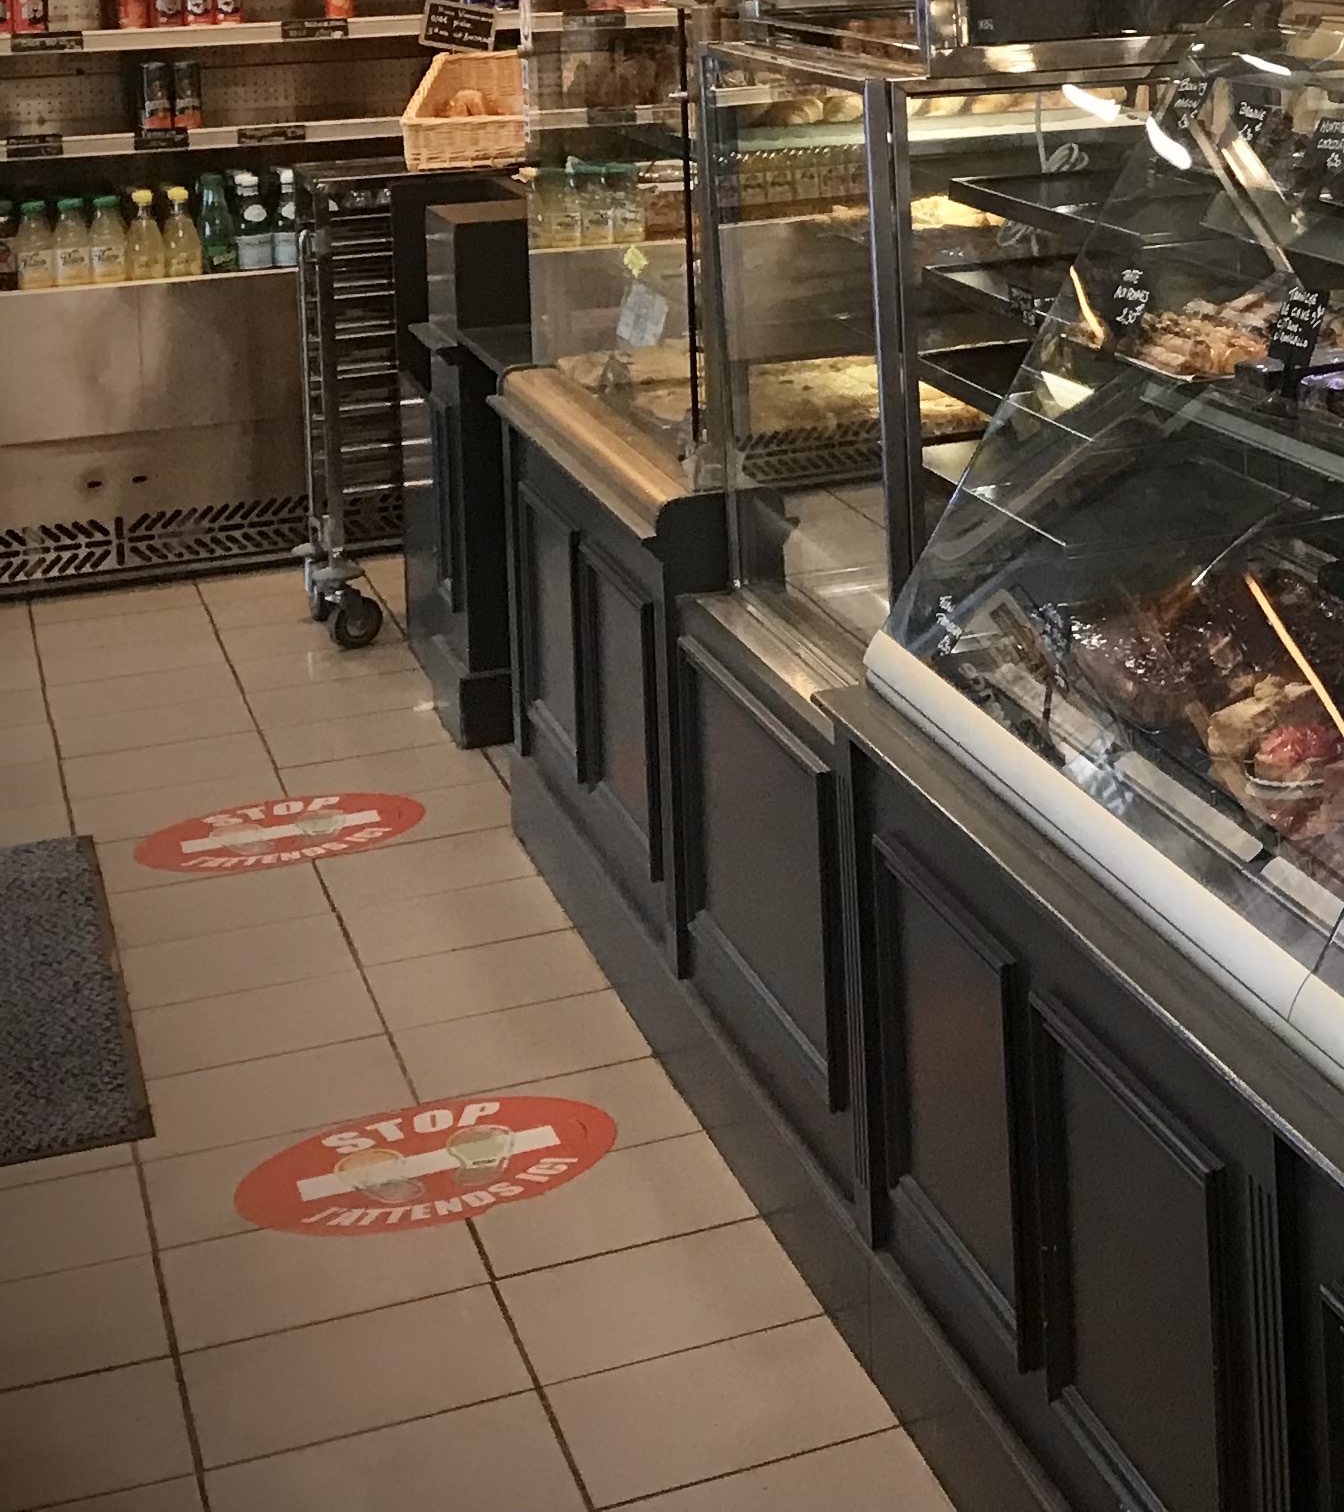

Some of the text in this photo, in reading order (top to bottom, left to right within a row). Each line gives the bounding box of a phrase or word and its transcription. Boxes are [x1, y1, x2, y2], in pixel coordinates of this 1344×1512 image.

[202, 796, 340, 827] STOP
[321, 1101, 500, 1154] STOP
[302, 1156, 579, 1227] J'ATTENDS ICI
